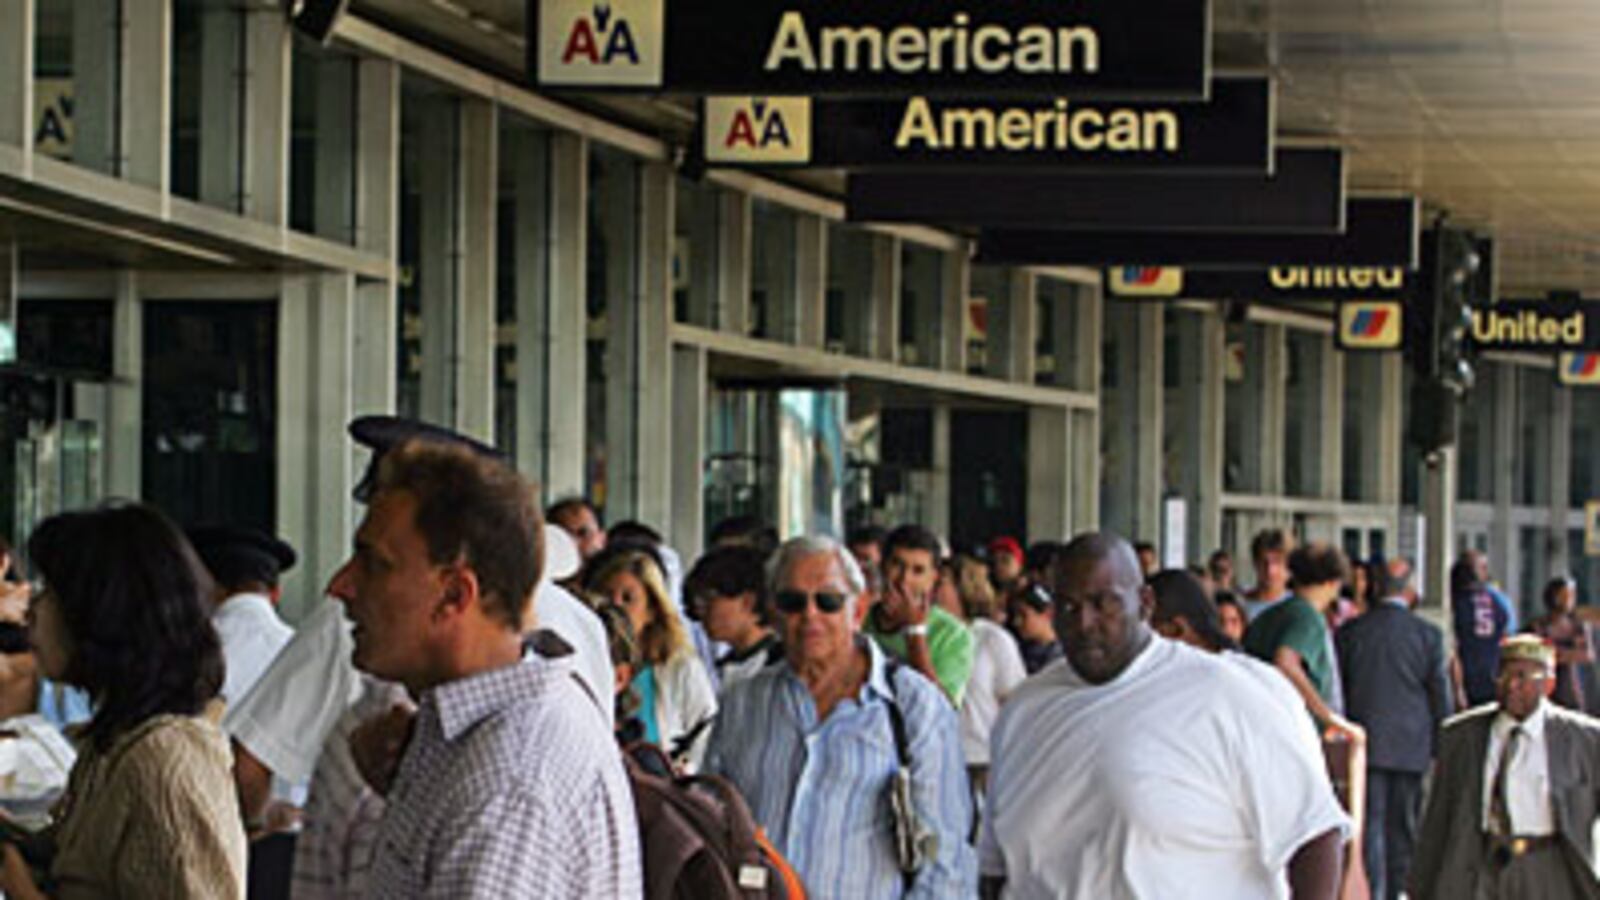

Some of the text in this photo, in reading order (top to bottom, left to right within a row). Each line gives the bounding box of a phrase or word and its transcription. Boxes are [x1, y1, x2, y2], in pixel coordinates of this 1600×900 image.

[764, 11, 1099, 73] American
[894, 97, 1180, 151] American
[1472, 311, 1583, 344] United
